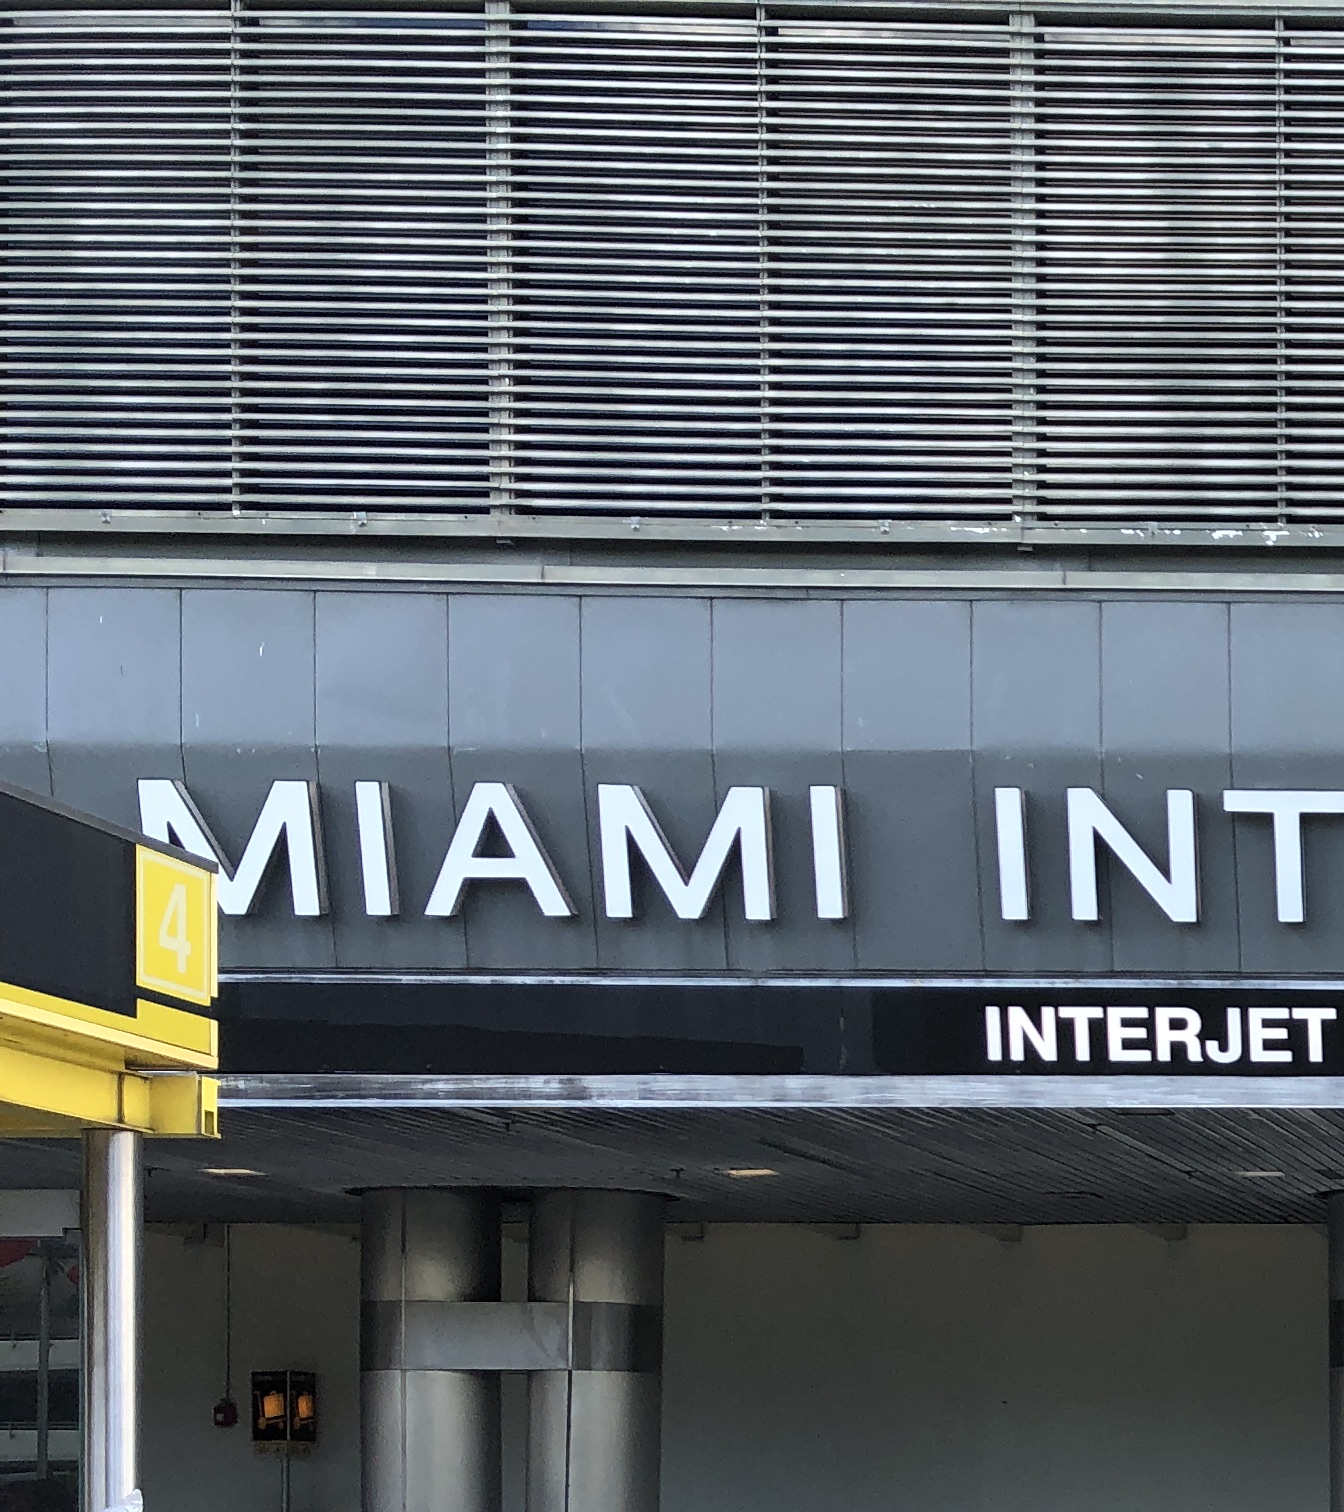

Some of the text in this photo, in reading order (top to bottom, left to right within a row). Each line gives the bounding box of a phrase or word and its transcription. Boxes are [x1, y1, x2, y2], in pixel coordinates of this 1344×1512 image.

[137, 778, 850, 921] MIAMI
[158, 882, 192, 974] 4
[985, 1005, 1338, 1064] INTERJET
